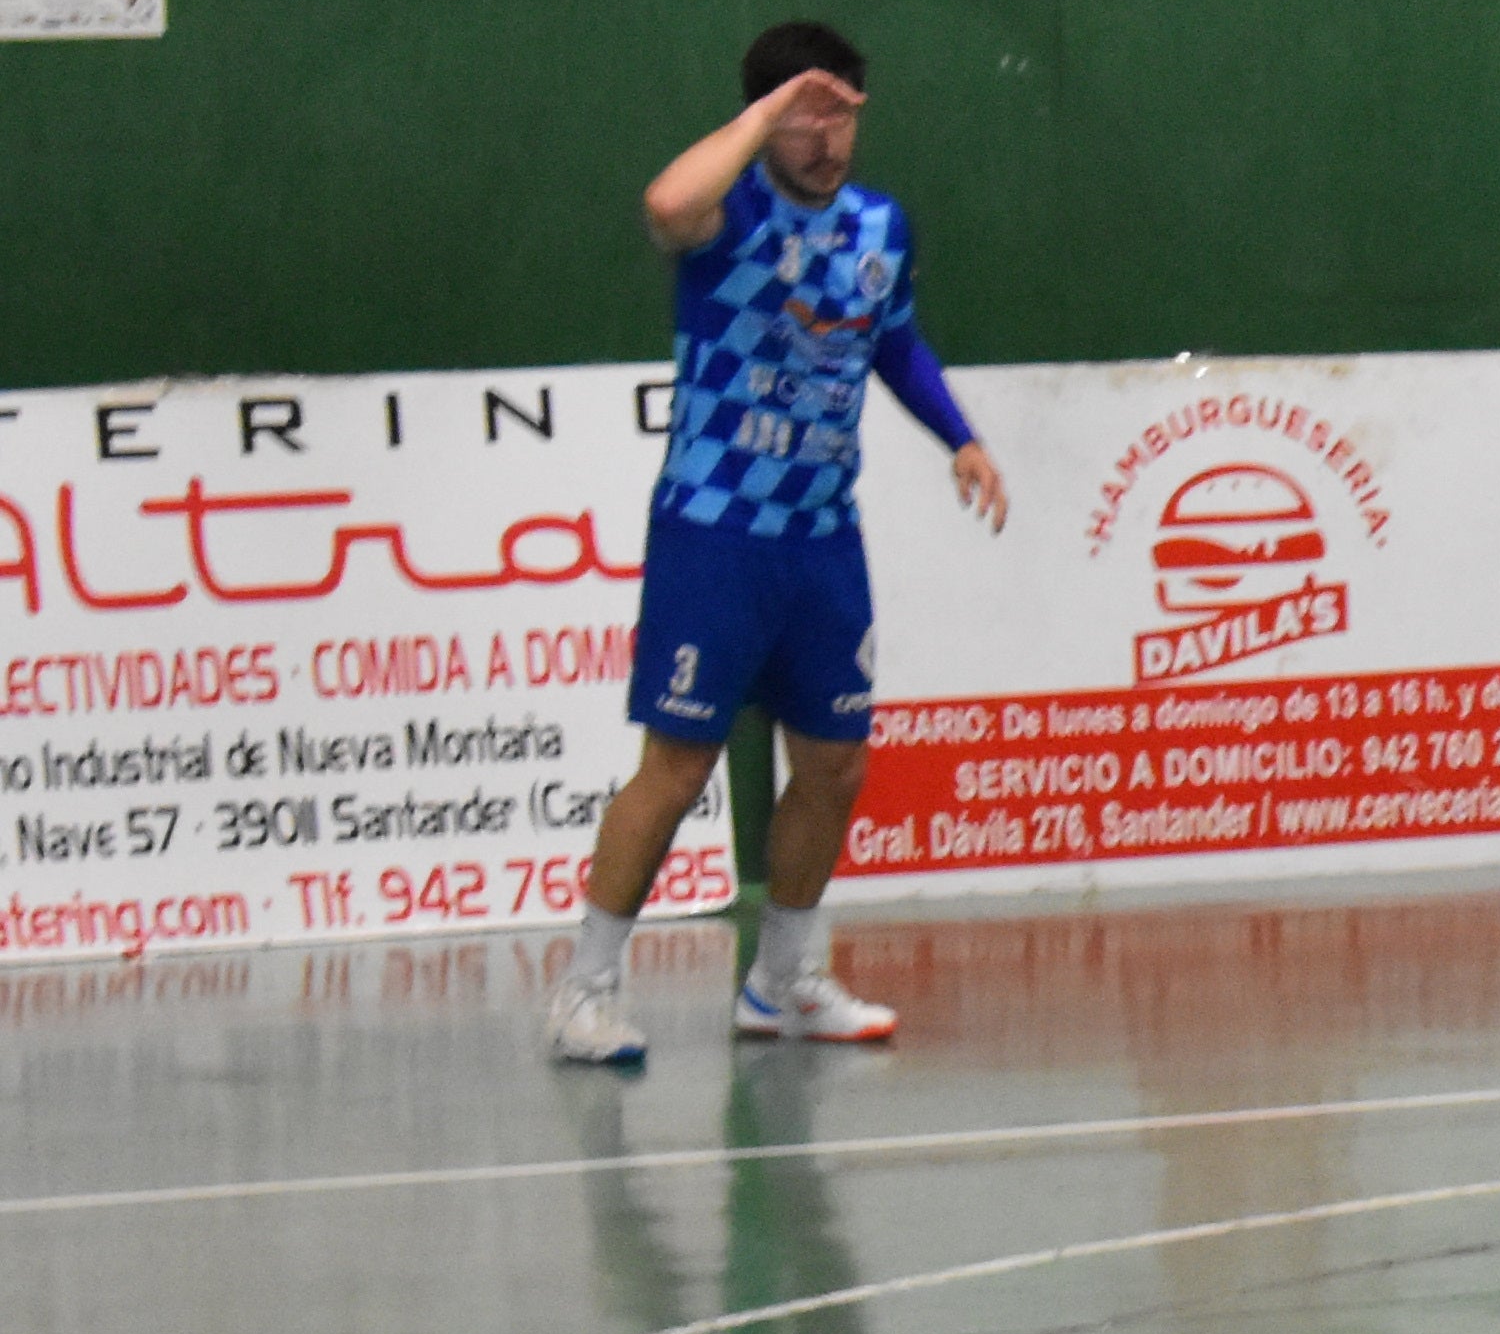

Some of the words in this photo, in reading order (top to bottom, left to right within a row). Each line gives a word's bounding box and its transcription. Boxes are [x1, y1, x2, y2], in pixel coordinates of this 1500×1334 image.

[1086, 393, 1392, 544] HAMBURGUESERIA
[0, 641, 281, 716] ECTIVIDADES
[310, 635, 472, 701] COMIDA
[487, 629, 516, 690] A
[669, 643, 699, 696] 3
[1139, 590, 1340, 680] DAVILA'S
[41, 730, 213, 792] Industrial
[226, 729, 267, 778] de
[277, 725, 397, 776] Nueva
[403, 715, 564, 769] Montaña
[868, 703, 997, 750] ORARIO:
[1003, 703, 1042, 741] De
[1048, 699, 1126, 738] lunes
[1131, 702, 1151, 733] a
[1155, 692, 1279, 734] domingo
[1284, 686, 1320, 723] de
[1326, 682, 1359, 721] 13
[1363, 687, 1382, 719] a
[1455, 681, 1477, 720] y
[954, 751, 1121, 802] SERVICIO
[1129, 749, 1155, 792] A
[1163, 736, 1353, 789] DOMICILIO:
[1361, 732, 1421, 777] 942
[17, 813, 116, 864] Nave
[127, 803, 181, 858] 57
[214, 793, 320, 851] 39011
[330, 786, 518, 844] Santander
[847, 812, 923, 867] Gral.
[928, 807, 1027, 861] Dávila
[1100, 790, 1255, 850] Santander
[287, 869, 367, 929] Tlf.
[378, 860, 491, 925] 942
[642, 845, 733, 905] 85
